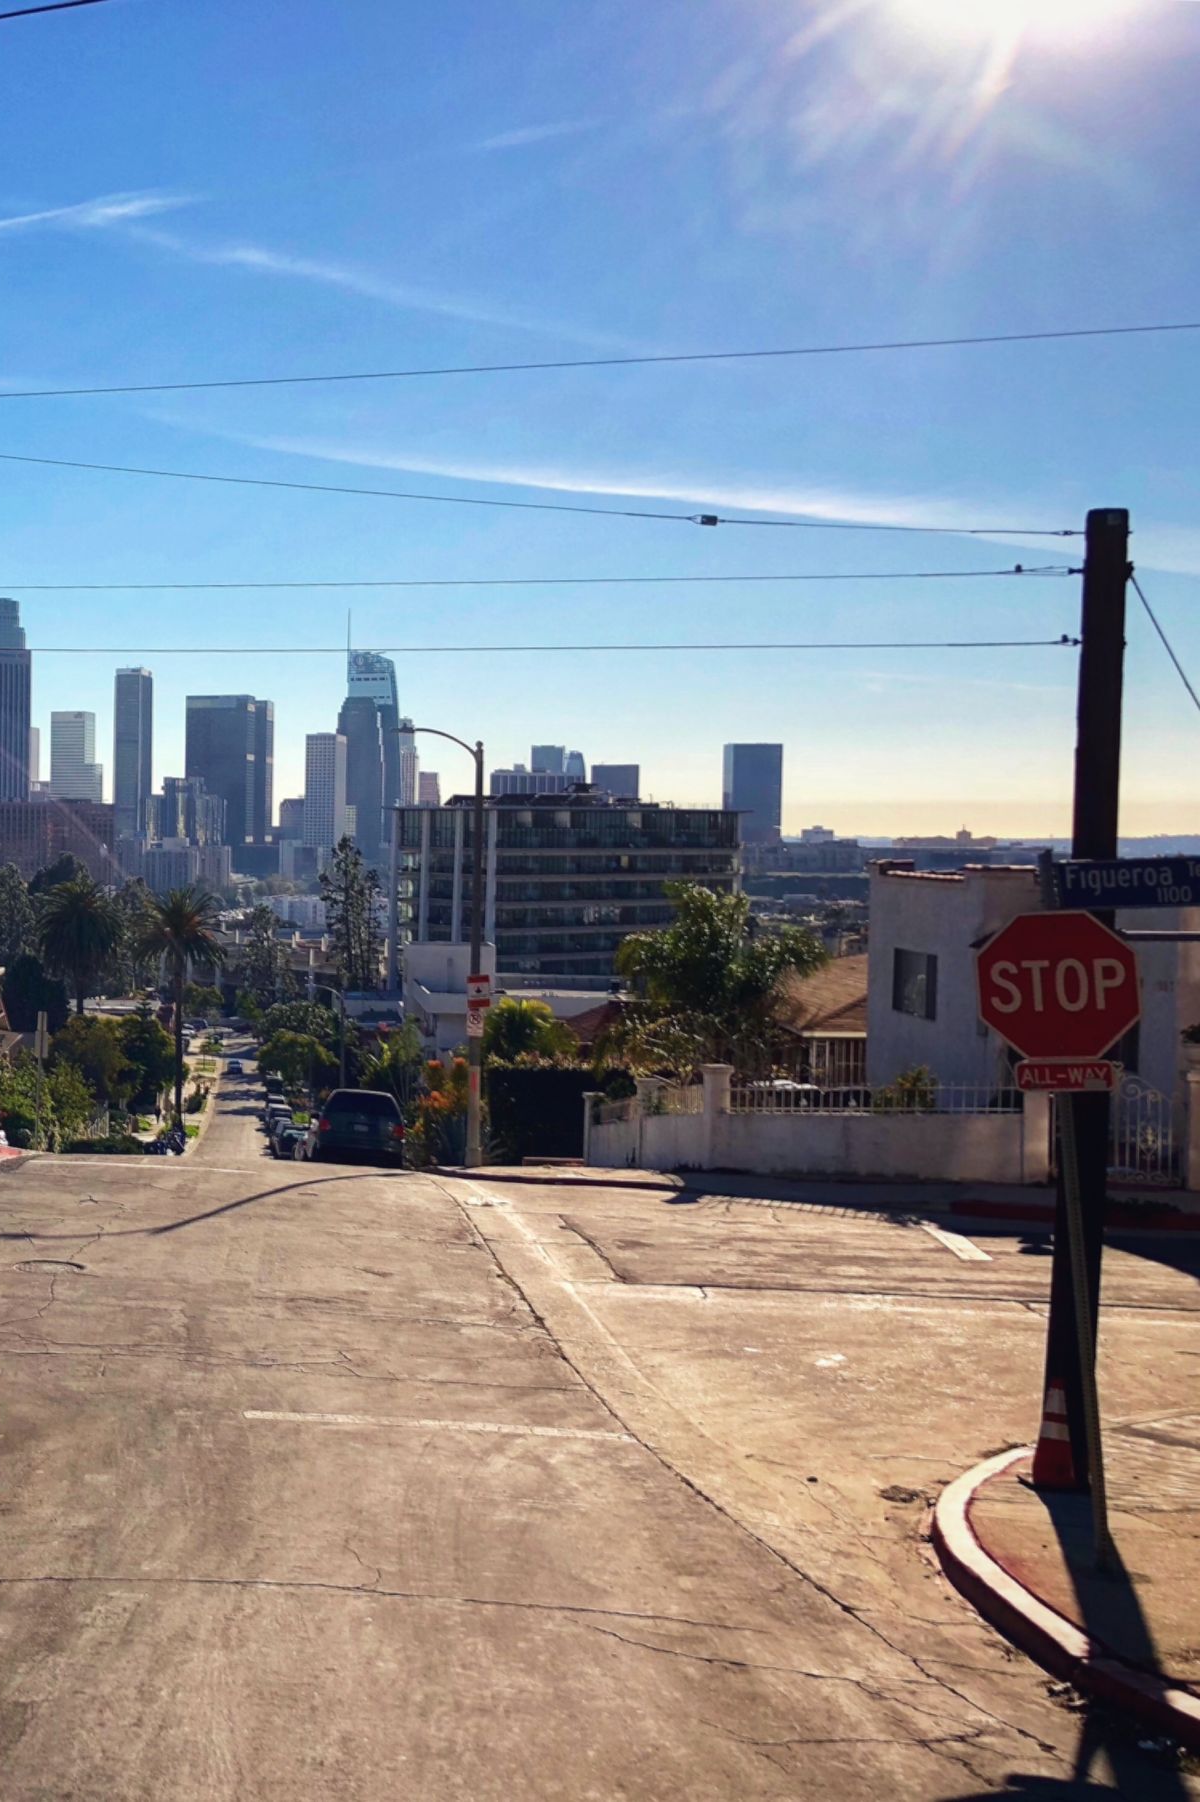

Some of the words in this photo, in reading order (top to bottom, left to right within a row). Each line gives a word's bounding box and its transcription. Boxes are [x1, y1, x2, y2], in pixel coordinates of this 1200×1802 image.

[1065, 865, 1173, 896] Figueroa
[1156, 885, 1193, 903] 1100
[990, 958, 1126, 1013] STOP
[1020, 1066, 1108, 1085] ALL-WAY
